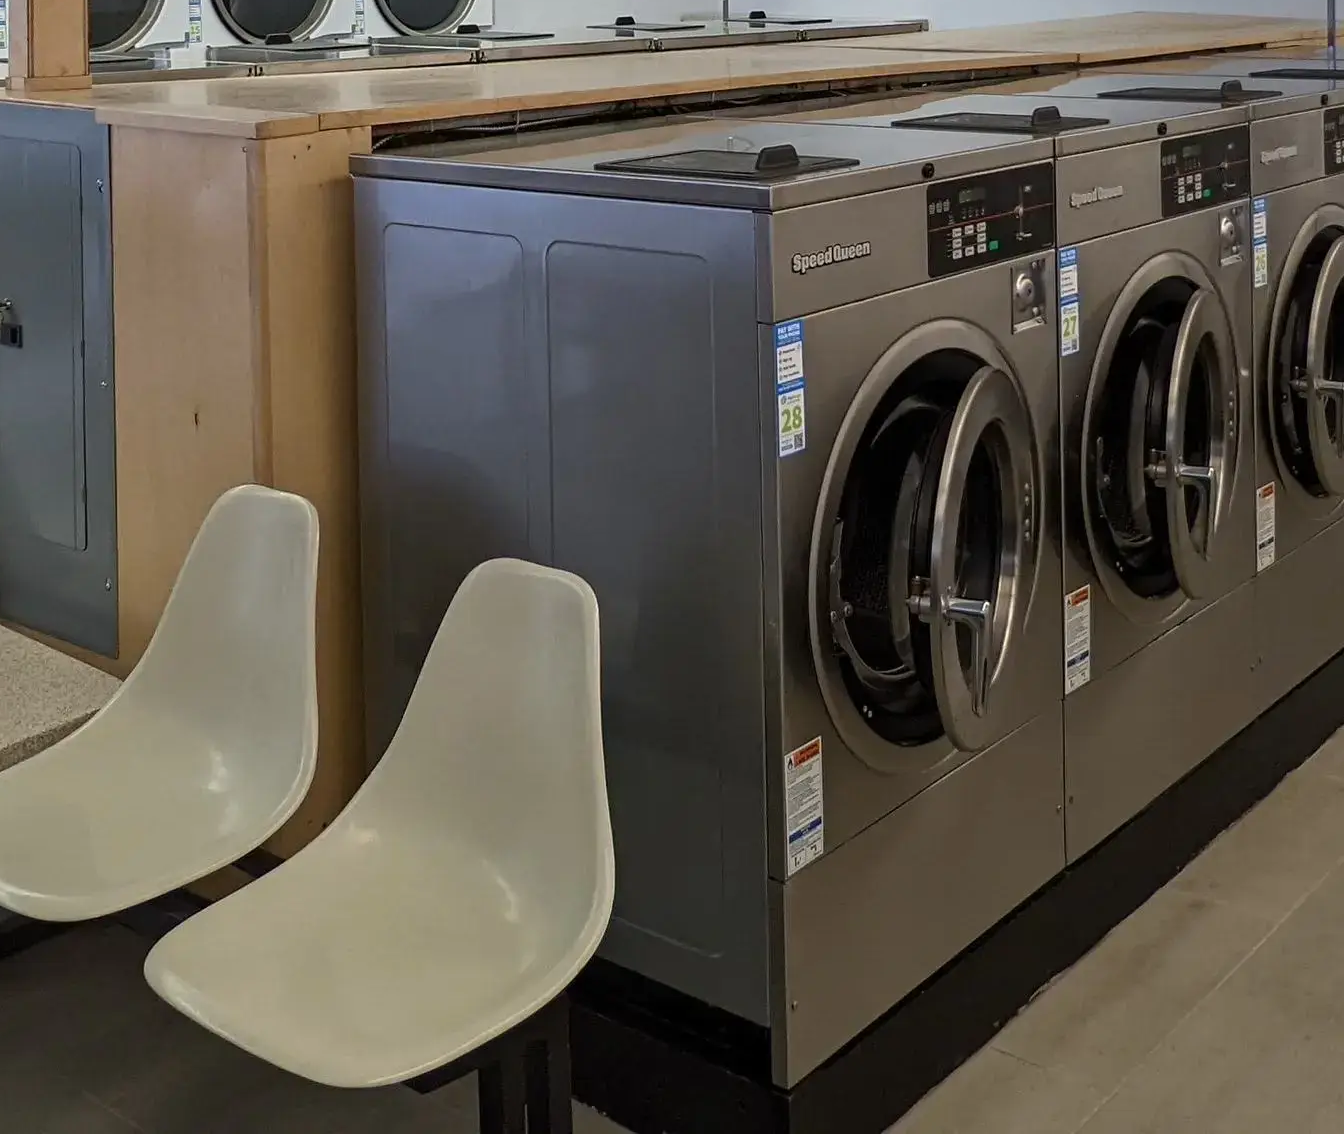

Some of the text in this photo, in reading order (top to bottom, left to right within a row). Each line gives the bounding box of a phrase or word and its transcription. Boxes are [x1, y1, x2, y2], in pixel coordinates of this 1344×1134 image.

[792, 243, 871, 275] Speed Queen
[1063, 315, 1077, 337] 27
[781, 406, 803, 434] 28
